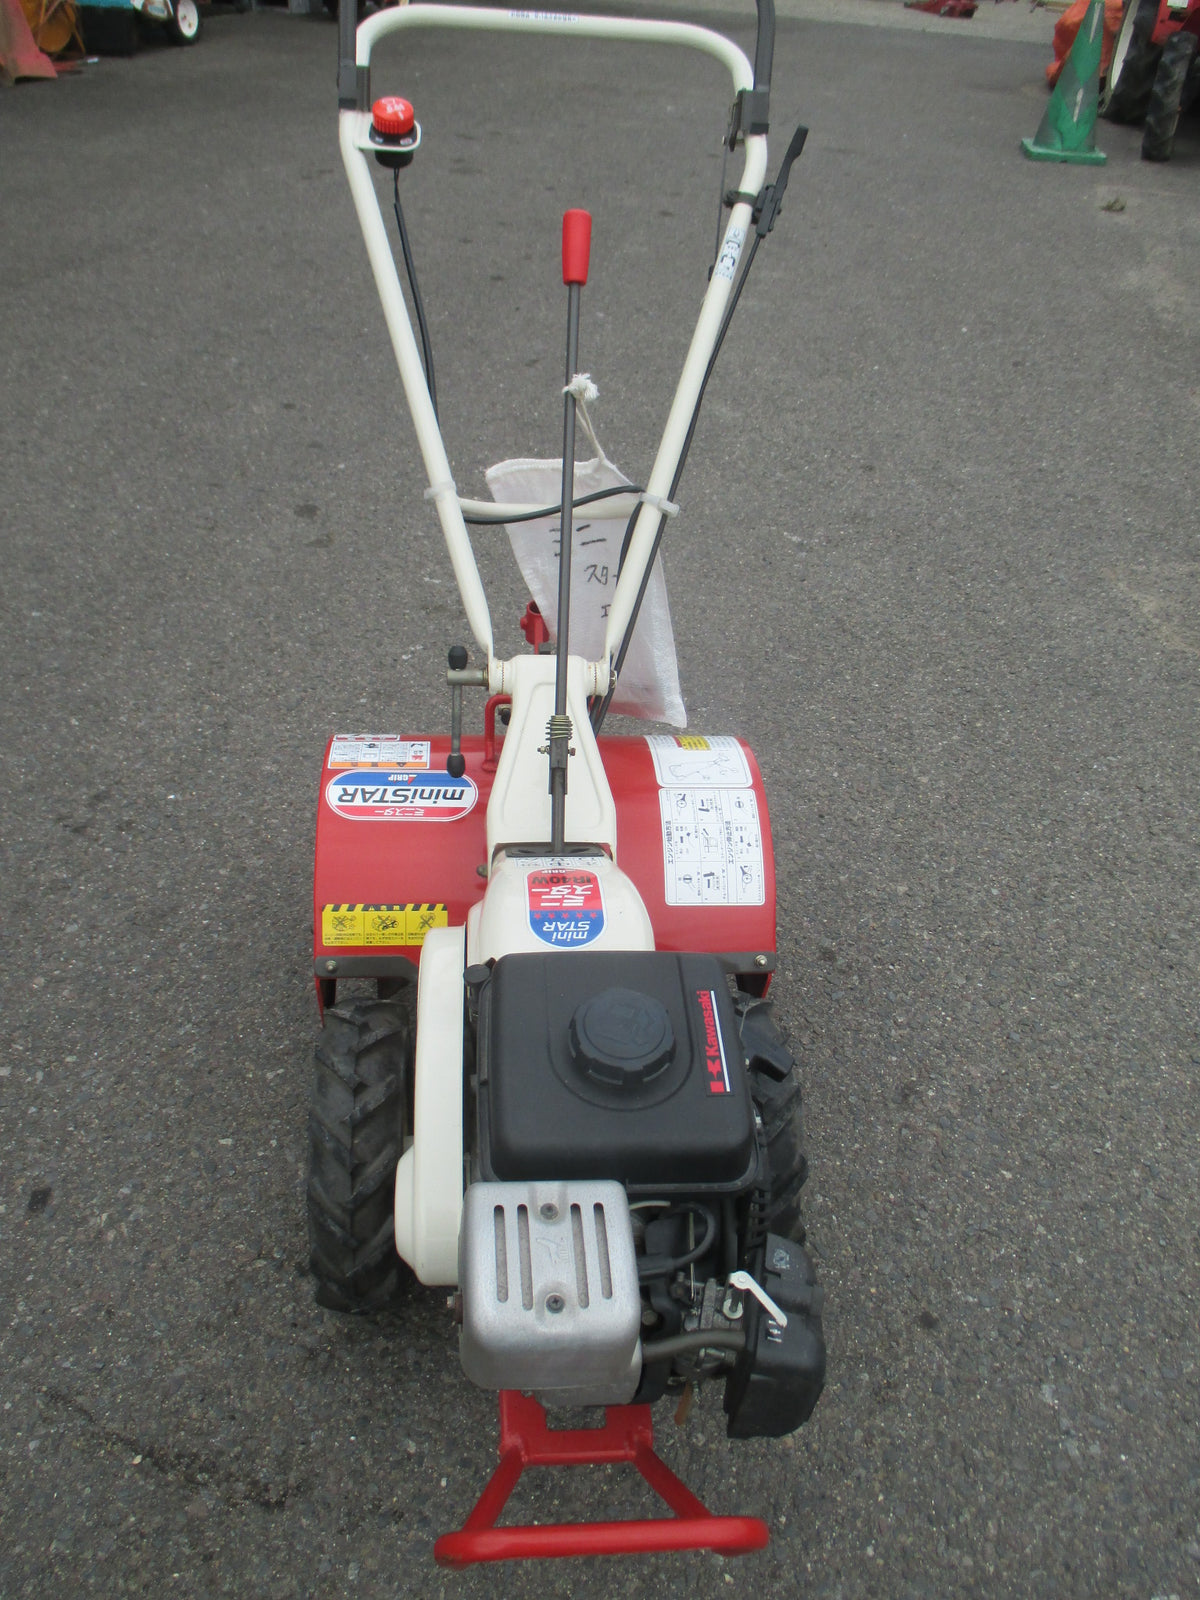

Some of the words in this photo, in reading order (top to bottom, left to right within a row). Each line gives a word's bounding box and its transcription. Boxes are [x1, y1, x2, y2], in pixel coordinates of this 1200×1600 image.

[583, 563, 618, 585] スタ
[337, 787, 465, 805] miniSTAR
[373, 807, 425, 817] ミニスター
[531, 884, 594, 895] スター
[540, 894, 585, 907] ミニ
[542, 920, 591, 932] STAR
[551, 931, 588, 942] mini
[696, 989, 720, 1057] Kawasaki
